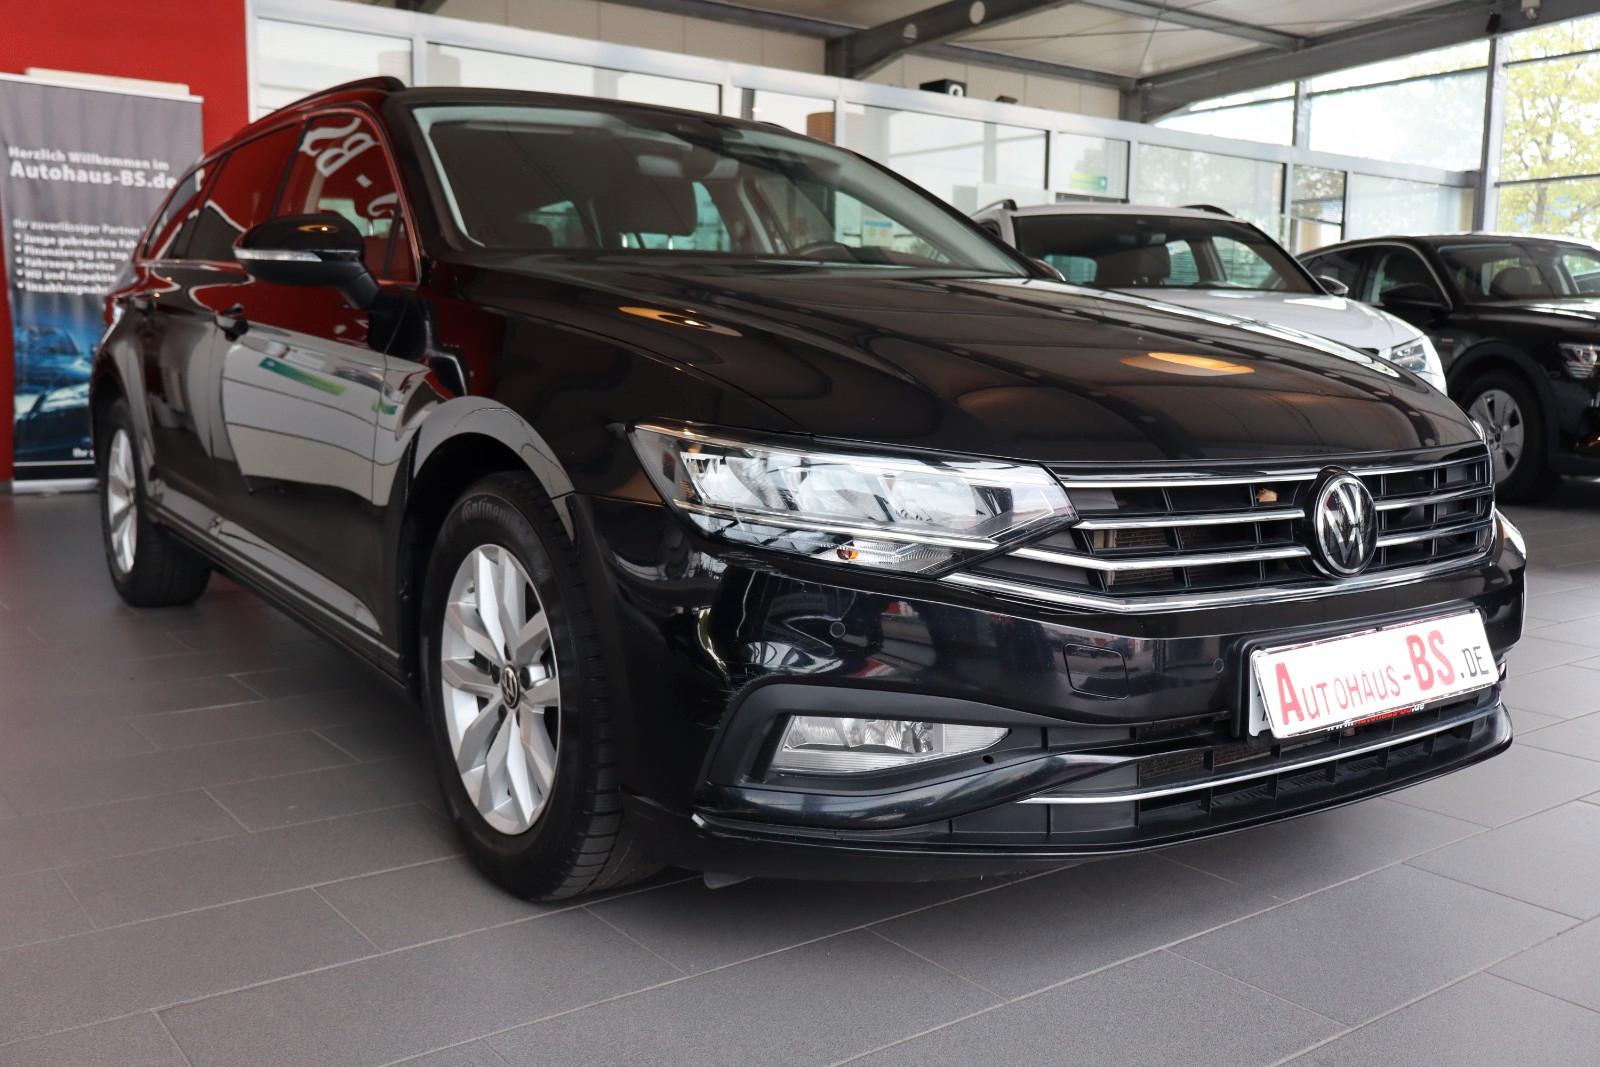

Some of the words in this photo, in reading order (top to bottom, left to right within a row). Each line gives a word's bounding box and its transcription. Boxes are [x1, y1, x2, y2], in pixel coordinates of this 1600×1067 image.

[8, 146, 66, 162] Herzlich
[68, 151, 150, 169] Willkommen
[152, 158, 170, 171] im
[10, 160, 177, 189] Autohaus-BS.de
[102, 223, 140, 235] Partner
[57, 236, 118, 248] gebrauchte
[23, 244, 94, 260] Finanzierung
[43, 270, 66, 281] und
